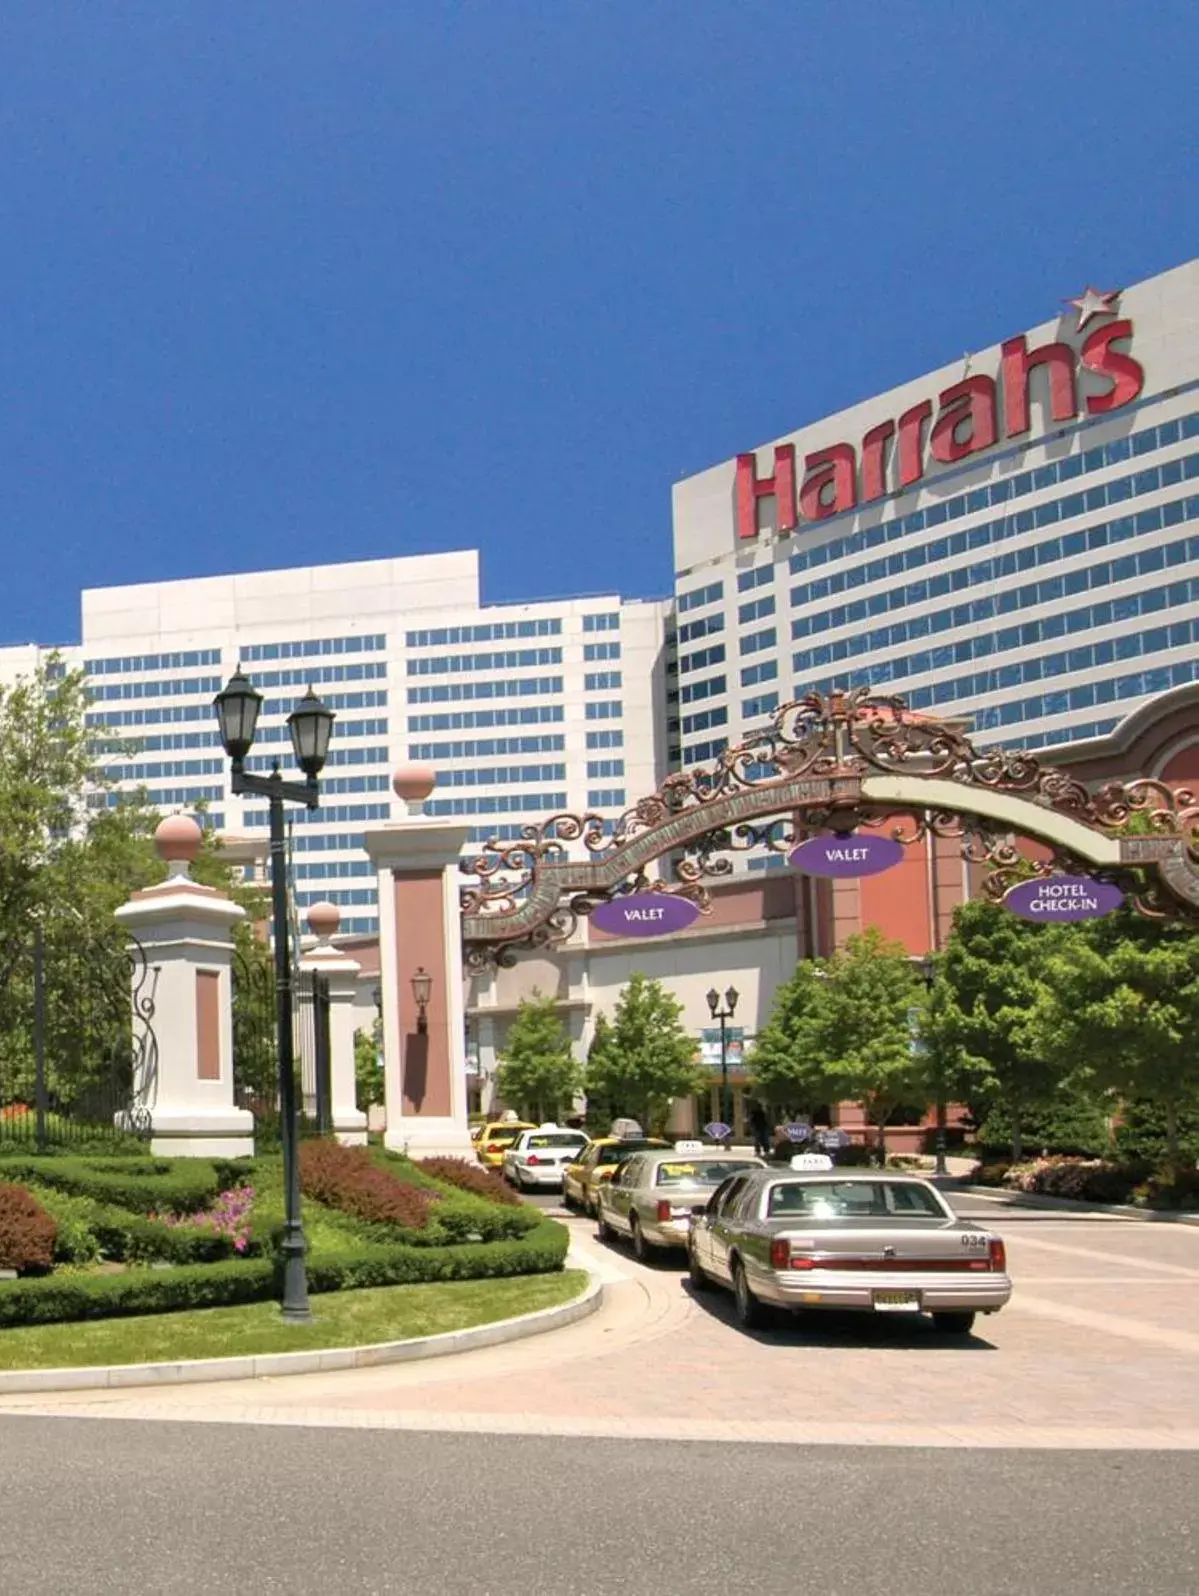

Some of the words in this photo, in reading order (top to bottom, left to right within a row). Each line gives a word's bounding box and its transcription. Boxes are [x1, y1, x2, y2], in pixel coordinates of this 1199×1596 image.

[736, 286, 1145, 539] Harrah's
[825, 848, 869, 861] VALET
[1038, 884, 1088, 898] HOTEL
[1029, 898, 1098, 912] CHECK-IN
[624, 908, 665, 921] VALET
[961, 1235, 986, 1247] 034
